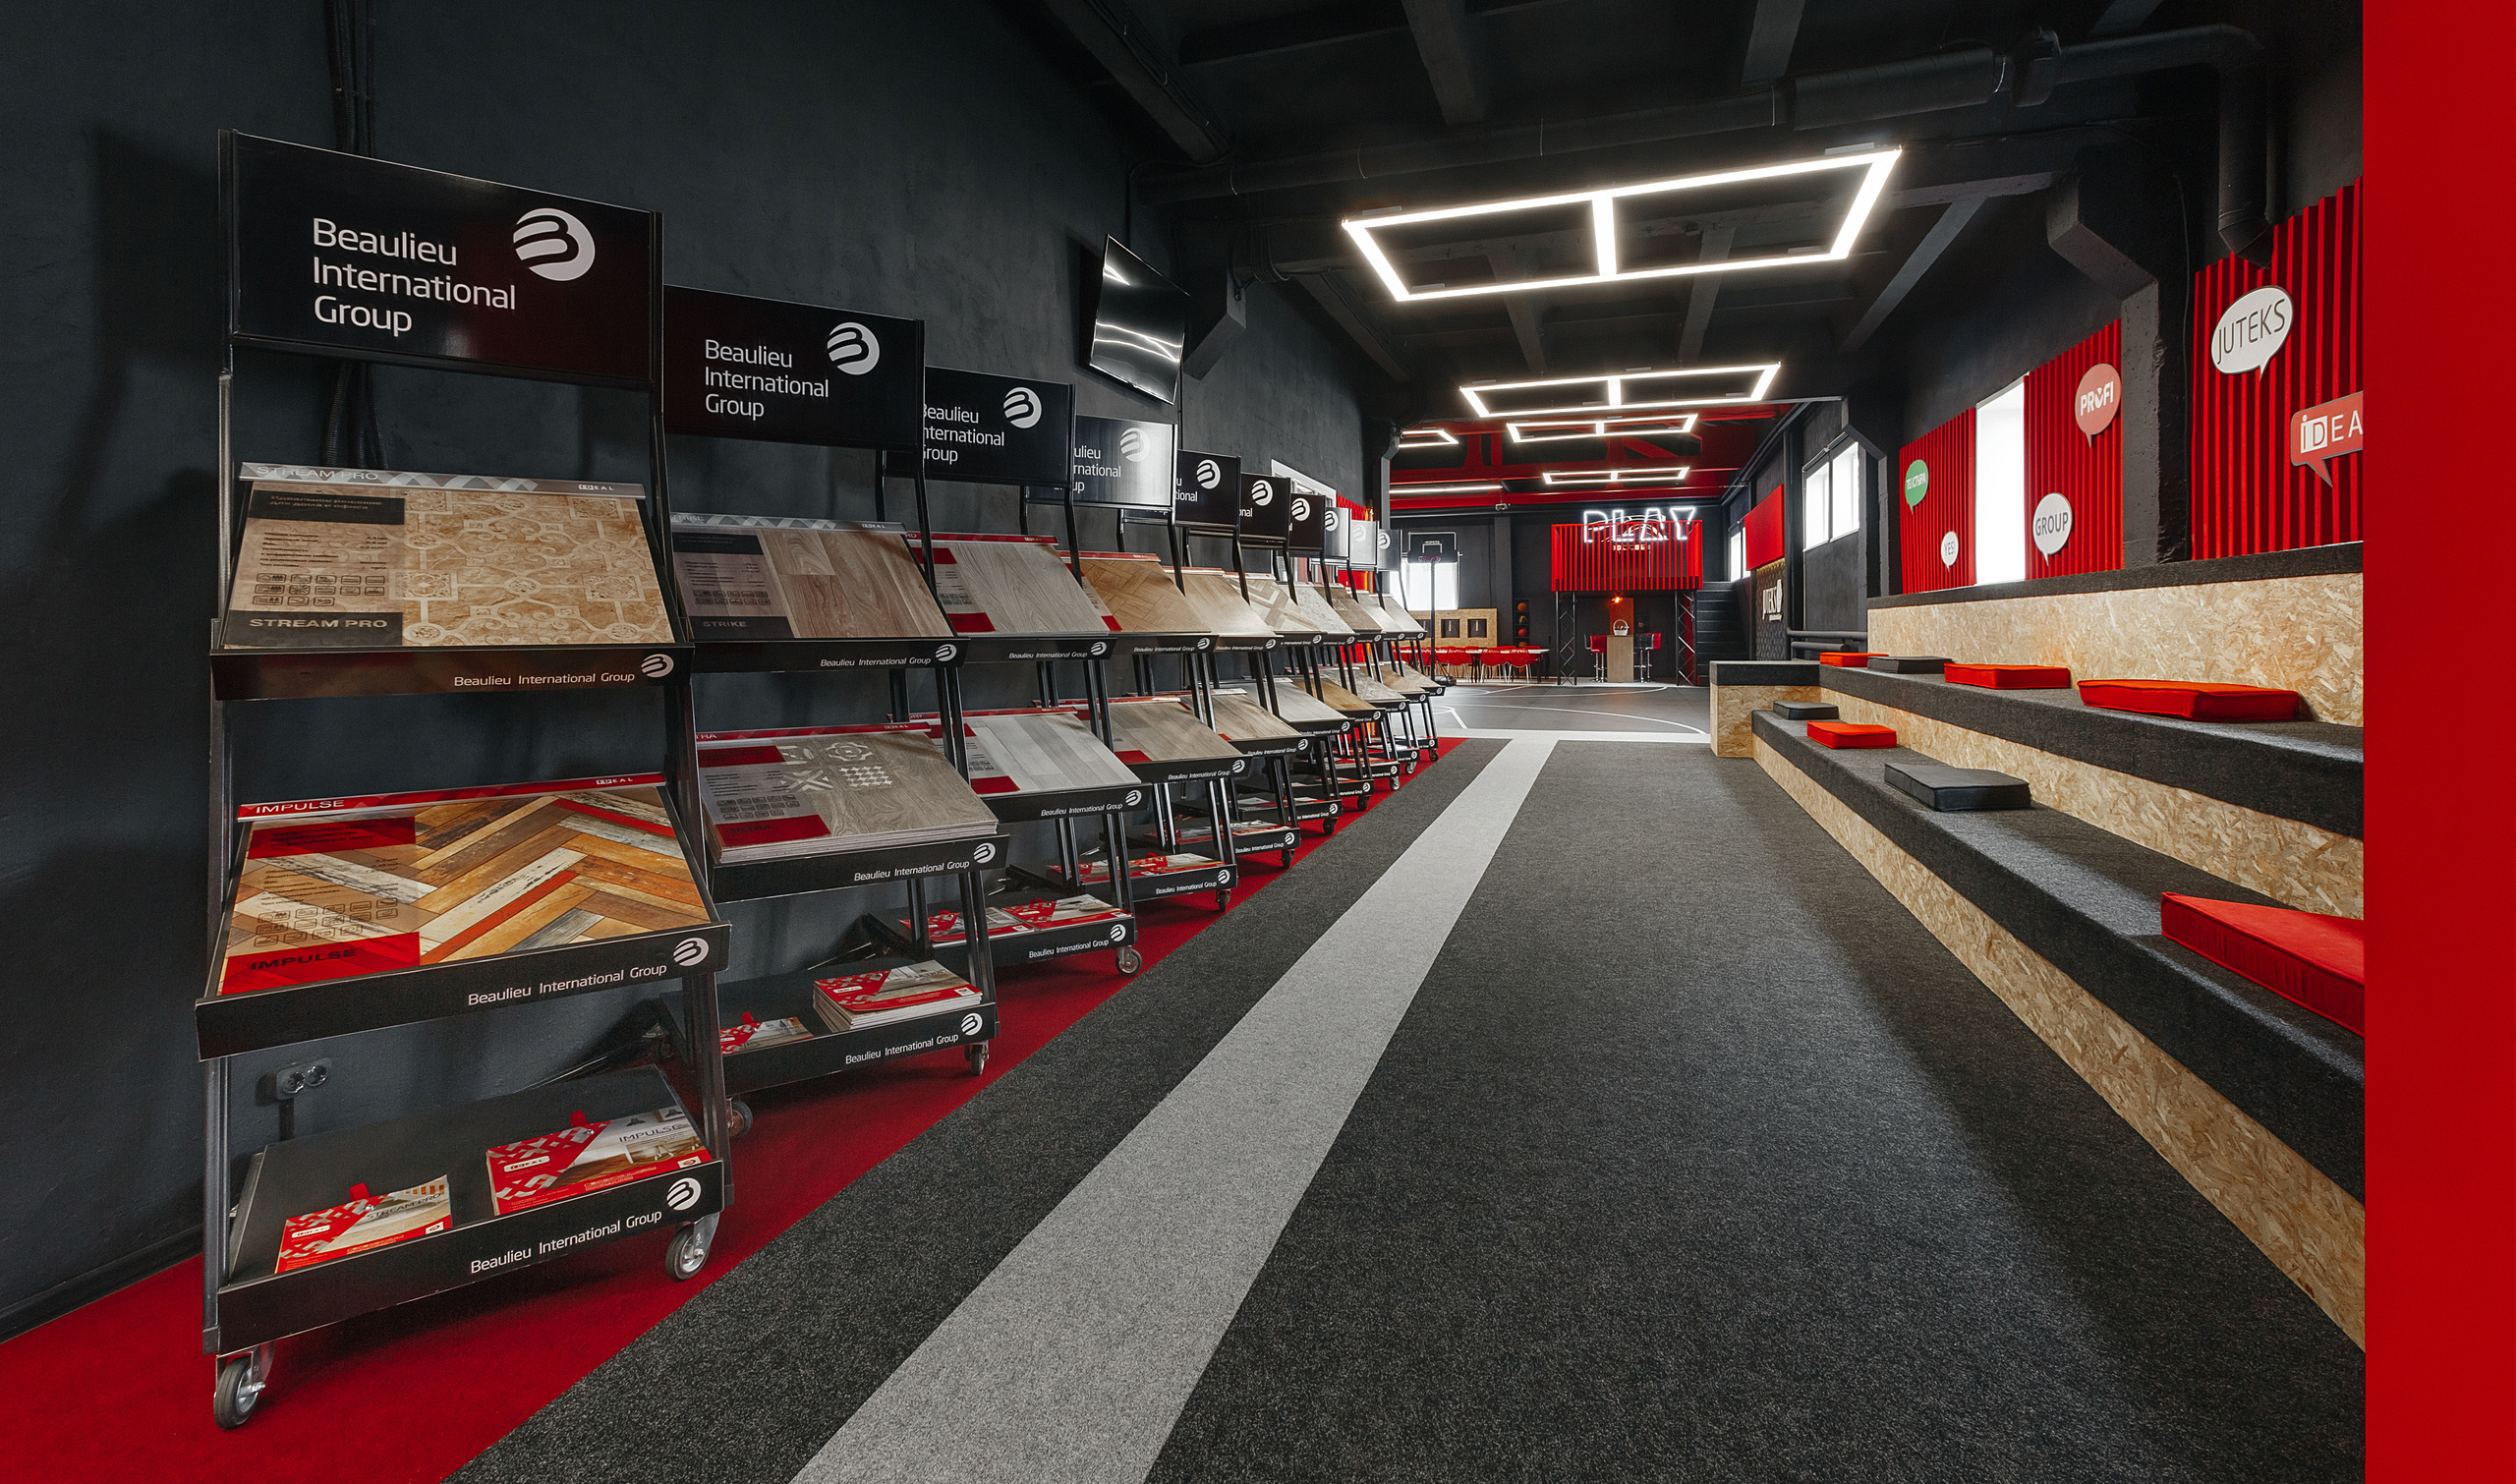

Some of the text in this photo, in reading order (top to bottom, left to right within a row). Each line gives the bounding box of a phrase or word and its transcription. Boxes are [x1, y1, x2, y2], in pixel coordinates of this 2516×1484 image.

[313, 217, 457, 266] Beaulieu
[313, 257, 516, 311] International
[314, 295, 413, 337] Group
[2217, 298, 2286, 365] JUTEKS
[705, 339, 792, 369] Beaulieu
[705, 366, 829, 398] International
[705, 394, 765, 421] Group
[257, 467, 379, 481] STREAM PRO
[1583, 506, 1696, 543] PLAY
[2034, 511, 2069, 537] GROUP
[250, 618, 388, 628] STREAM PRO
[821, 656, 931, 667] Beaulieu International Group
[454, 671, 635, 687] Beaulieu International Group
[256, 799, 345, 814] IMPULSE
[1041, 802, 1123, 817] Beaulieu International Group
[854, 858, 970, 883] Beaulieu International Group
[251, 948, 358, 972] IMPULSE
[1029, 938, 1110, 959] Beaulieu International Group
[468, 963, 667, 1005] Beaulieu International Group
[845, 1032, 959, 1064] Beaulieu International Group
[619, 1124, 683, 1143] IMPULSE
[366, 1192, 442, 1220] STREAM PRO
[471, 1209, 662, 1274] Beaulieu International Group
